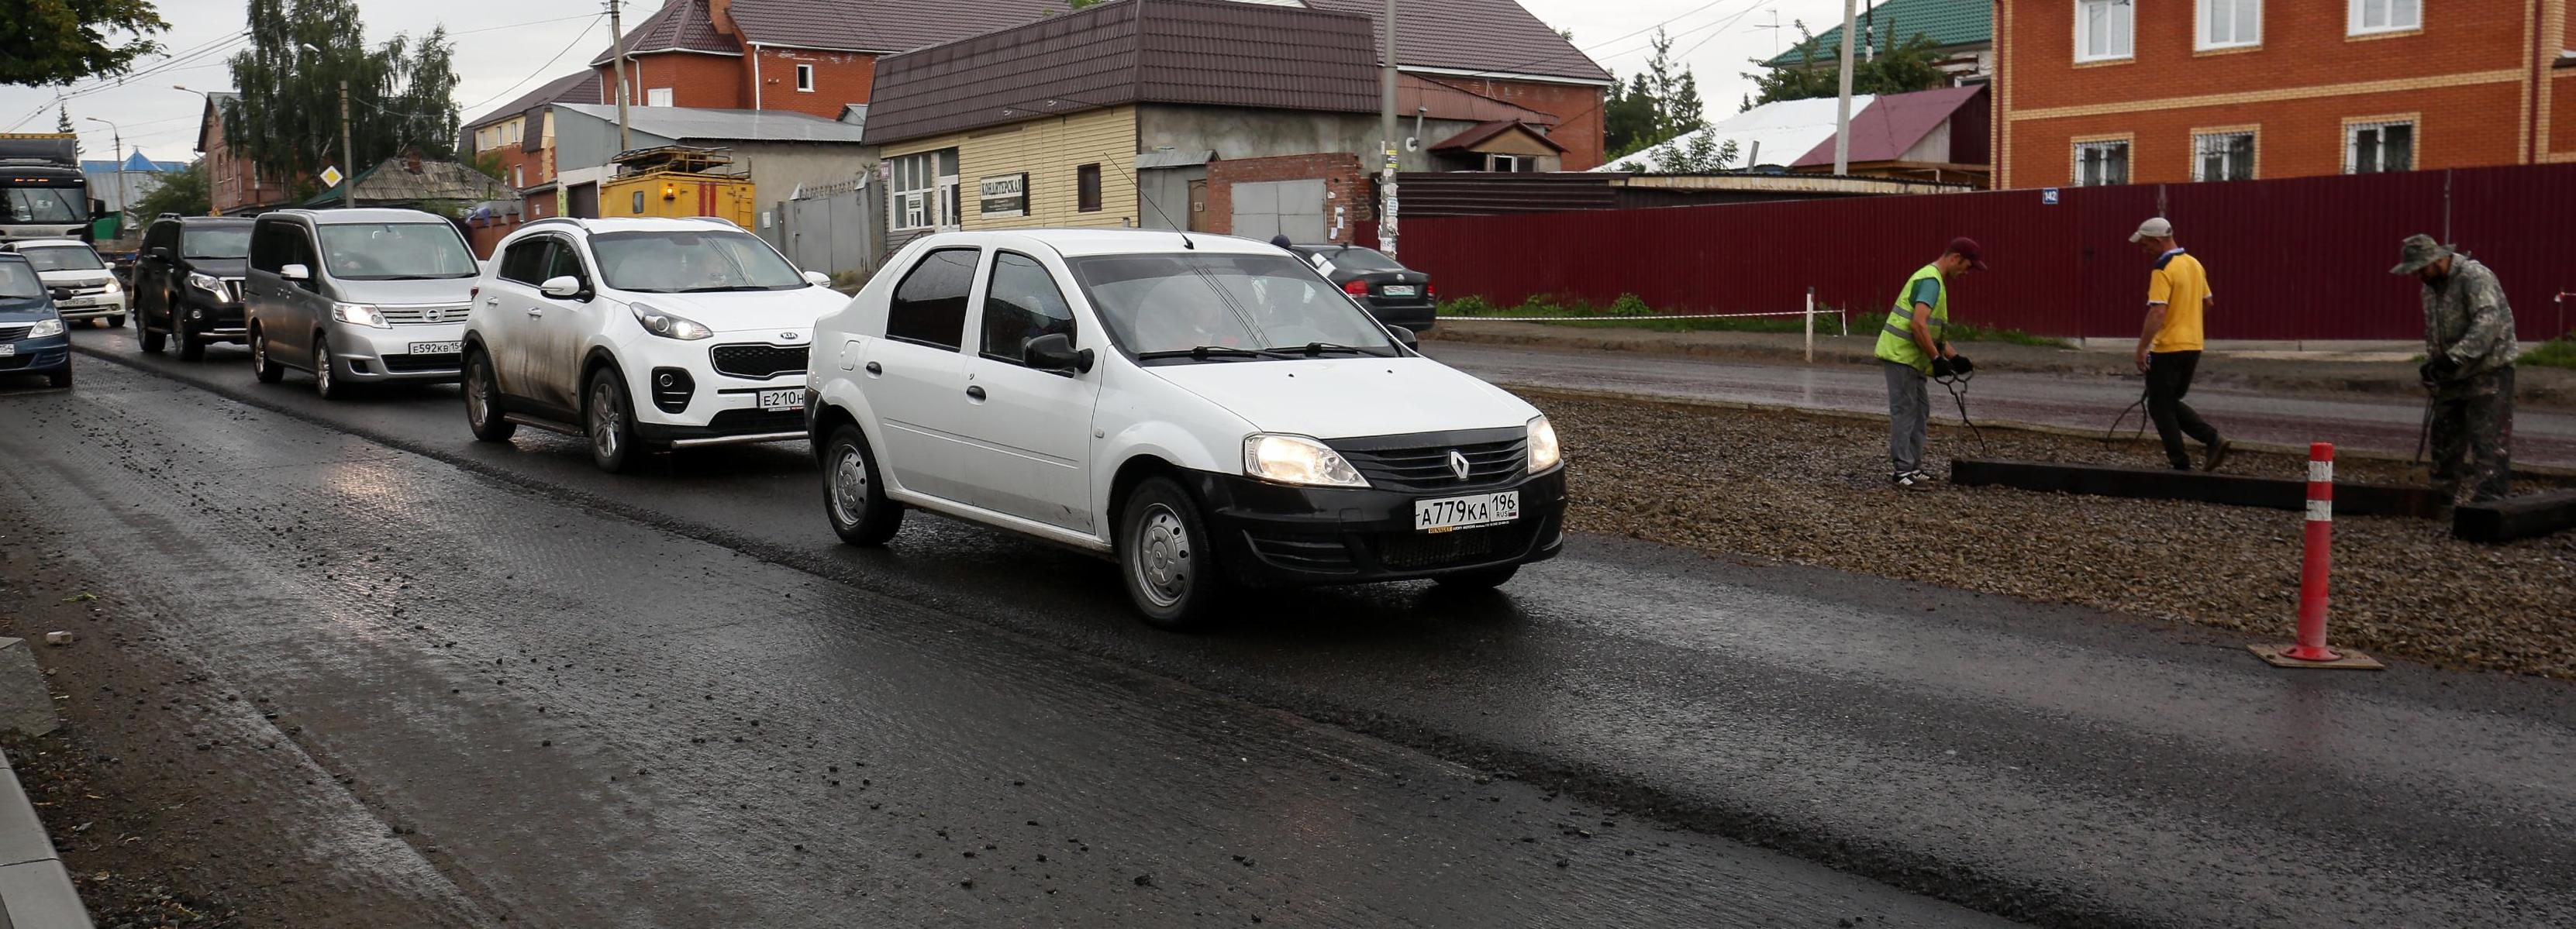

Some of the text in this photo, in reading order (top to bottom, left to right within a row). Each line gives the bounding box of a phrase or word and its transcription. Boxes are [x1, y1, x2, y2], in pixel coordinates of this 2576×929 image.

[413, 344, 449, 353] Е592КВ
[1422, 494, 1516, 525] А779КА 196
